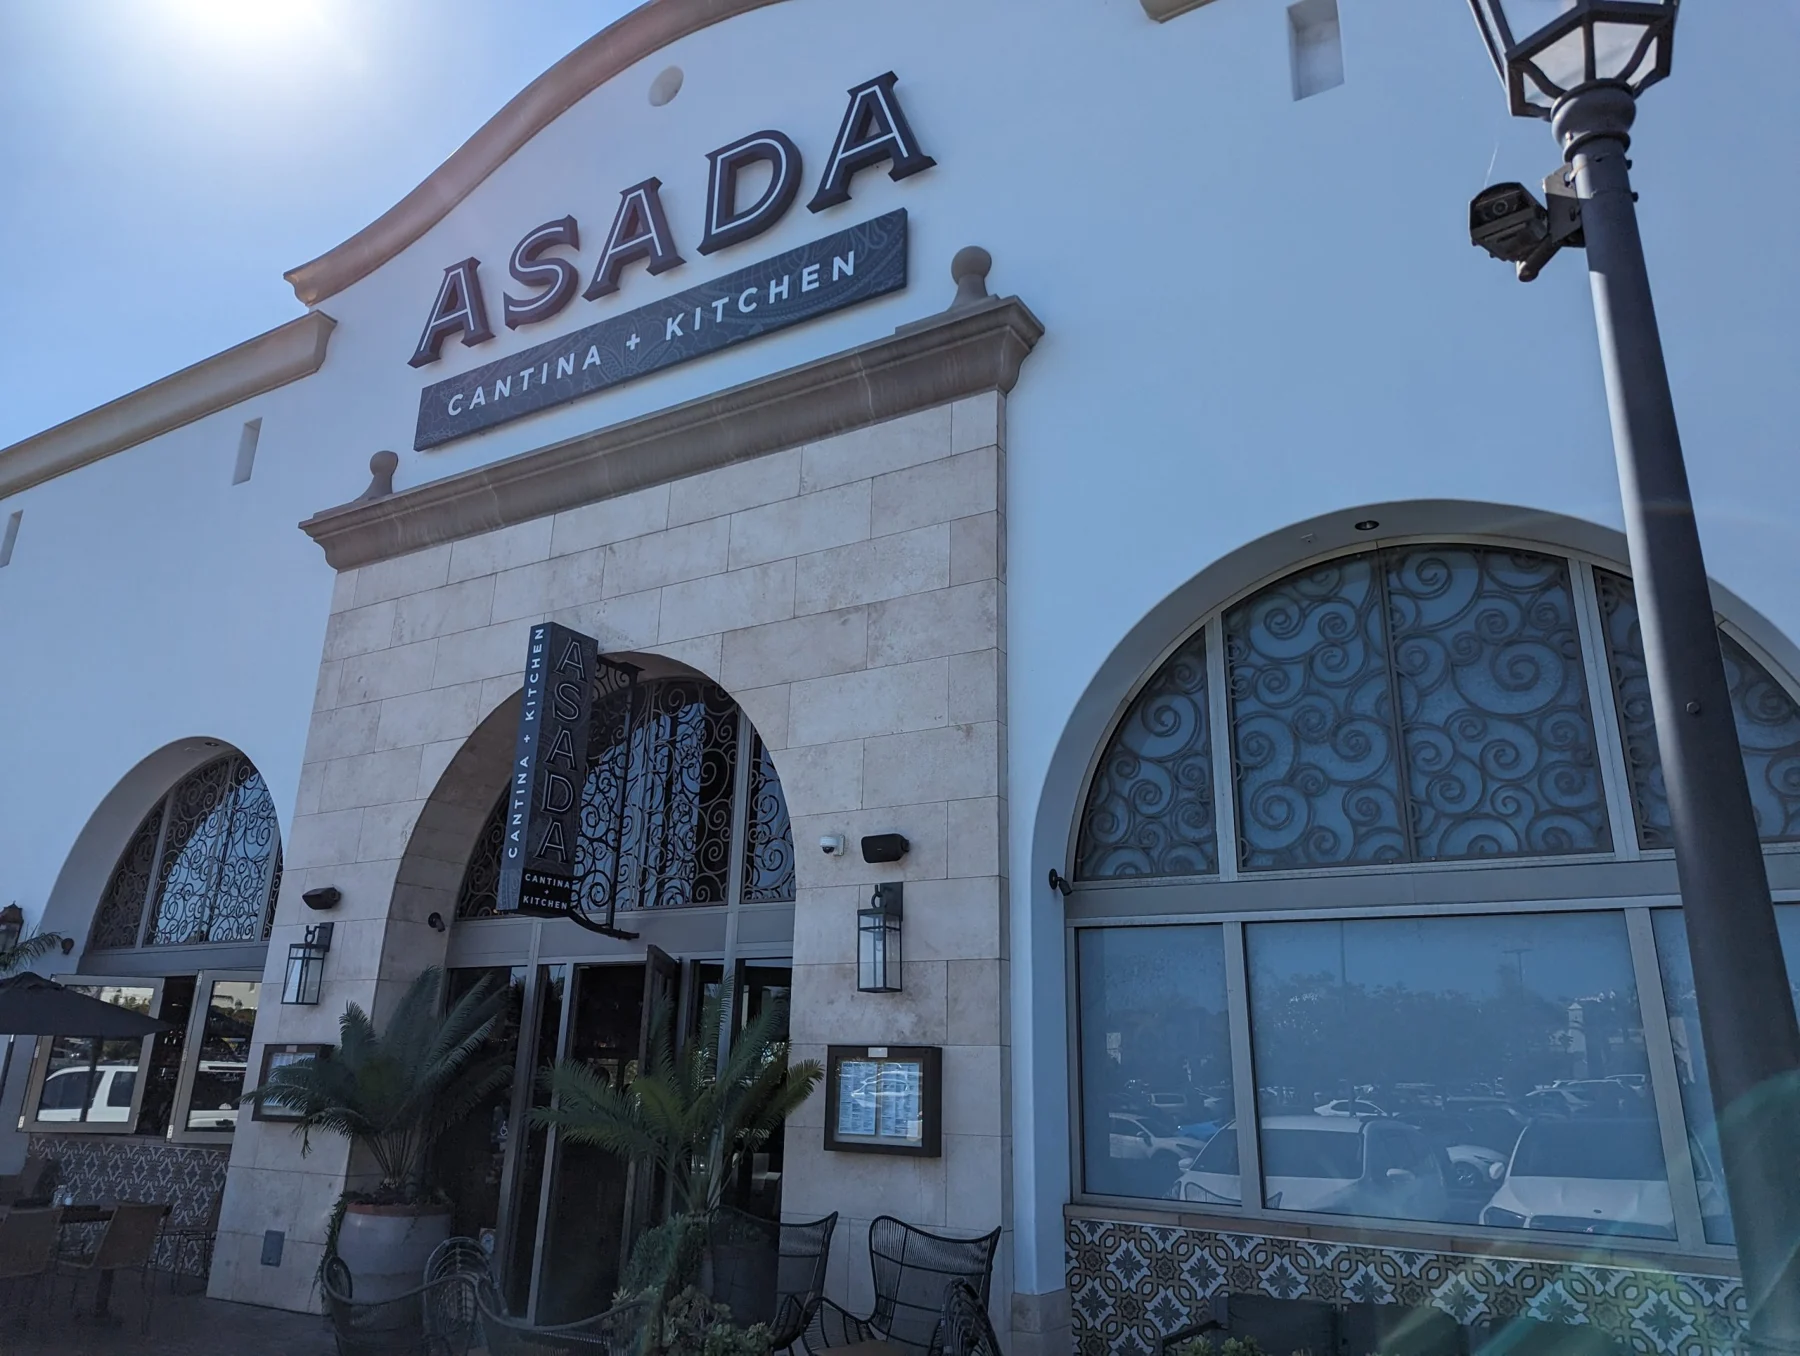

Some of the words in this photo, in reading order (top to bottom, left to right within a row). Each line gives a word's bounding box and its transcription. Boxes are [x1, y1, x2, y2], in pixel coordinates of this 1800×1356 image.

[408, 70, 937, 368] ASADA
[447, 348, 602, 416] CANTINA
[665, 251, 855, 341] KITCHEN
[508, 756, 530, 859] CANTINA
[525, 628, 545, 721] KITCHEN
[533, 637, 587, 864] ASADA
[523, 895, 568, 909] KITCHEN
[525, 874, 570, 889] CANTINA
